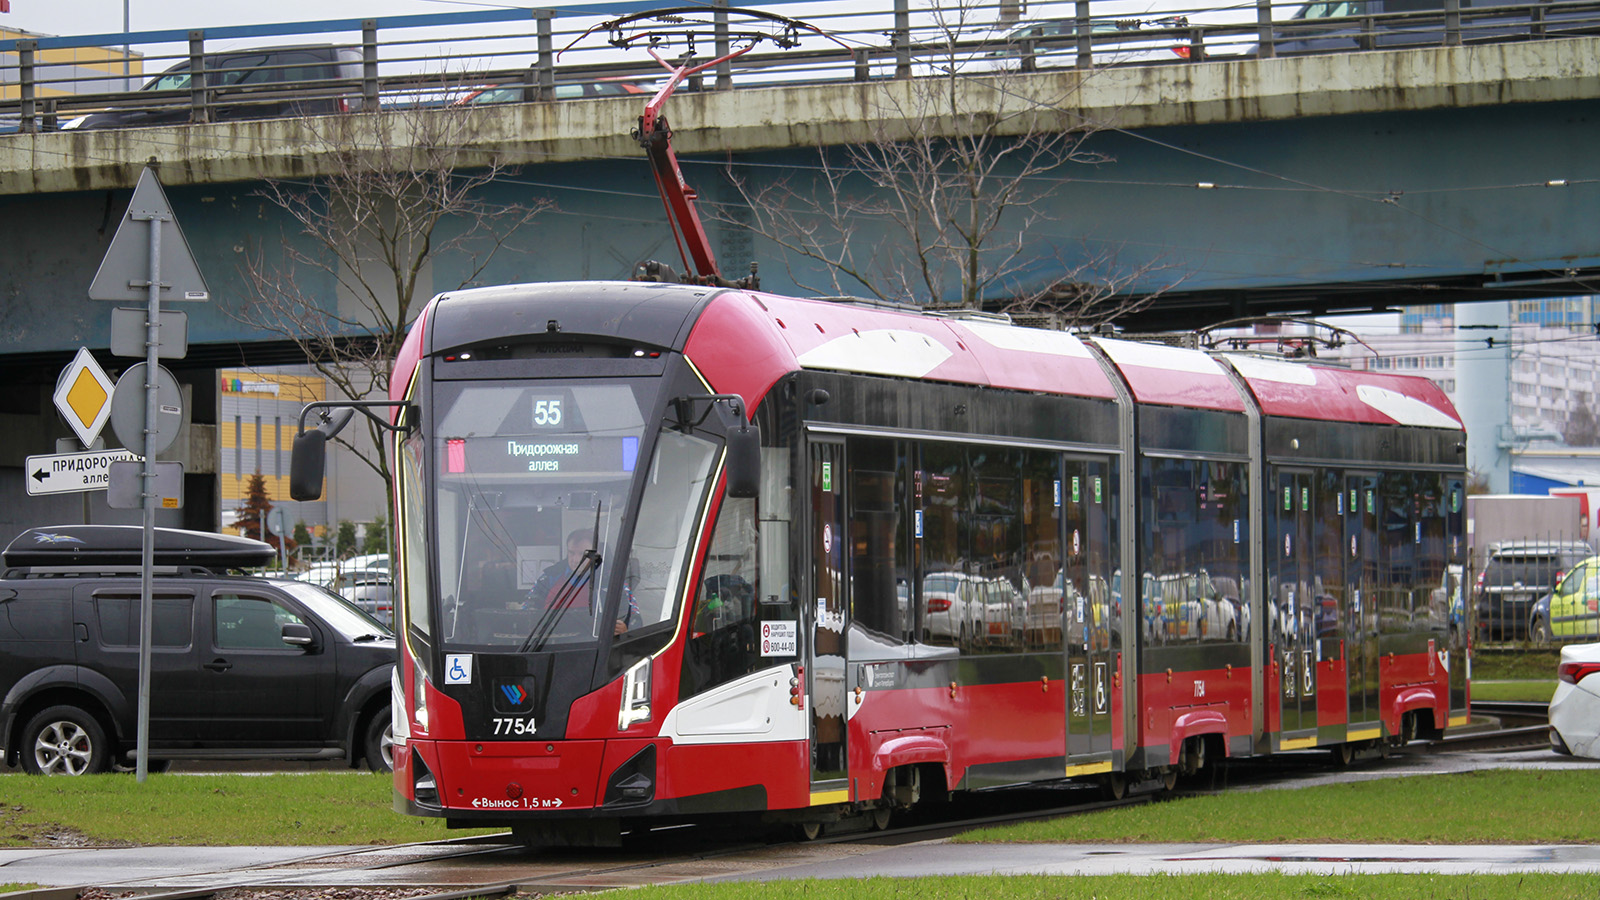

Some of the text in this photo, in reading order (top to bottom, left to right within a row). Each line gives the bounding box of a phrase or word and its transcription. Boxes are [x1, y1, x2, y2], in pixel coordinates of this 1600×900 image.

[534, 400, 561, 426] 55
[507, 441, 579, 457] Придорожная
[528, 460, 559, 471] аллея
[83, 473, 109, 484] алле
[771, 642, 794, 651] 600-44-00
[1194, 680, 1205, 697] 7754
[493, 718, 537, 735] 7754
[481, 797, 552, 809] Вынос 1,5 м
